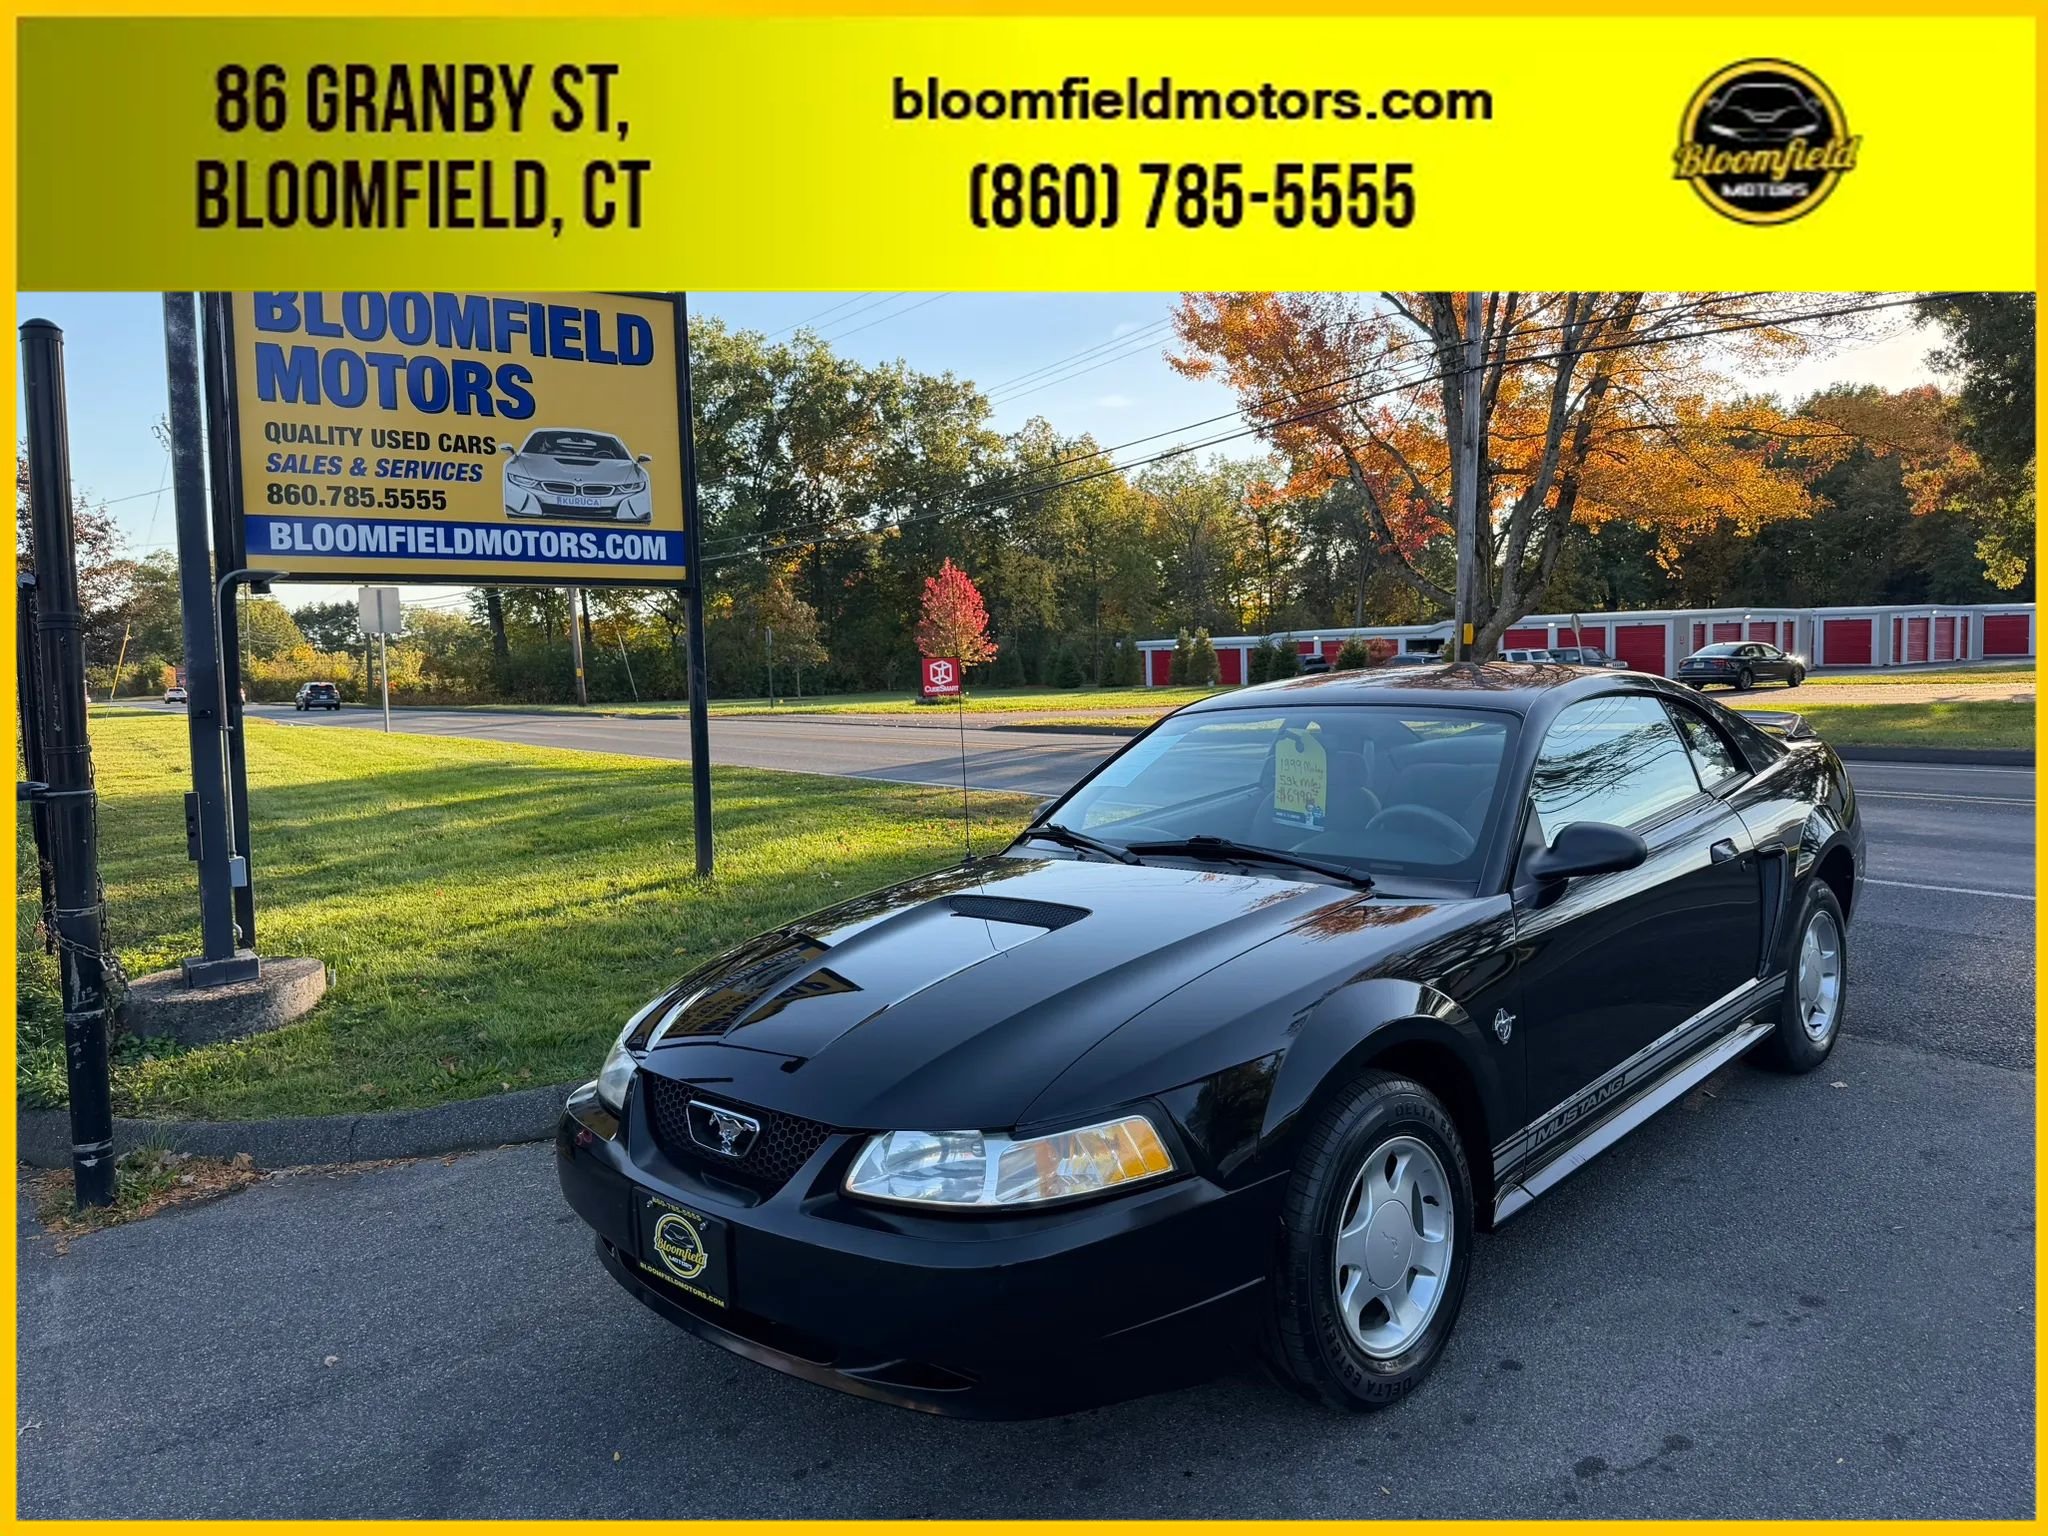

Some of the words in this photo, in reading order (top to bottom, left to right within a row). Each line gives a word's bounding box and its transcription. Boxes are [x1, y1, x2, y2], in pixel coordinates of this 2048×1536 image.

[254, 291, 654, 366] BLOOMFIELD
[254, 342, 536, 420] MOTORS
[265, 421, 363, 448] QUALITY
[371, 427, 431, 452] USED
[438, 431, 497, 456] CARS
[265, 452, 342, 477] SALES
[350, 455, 367, 477] &
[374, 458, 483, 483] SERVICES
[266, 483, 448, 511] 860.785.5555
[269, 521, 667, 561] BLOOMFIELDMOTORS.COM
[1394, 1102, 1436, 1125] DELTA
[1535, 1076, 1625, 1144] MUSTANG
[657, 1238, 705, 1266] Bloomfield
[640, 1261, 725, 1308] BLOOMFIELDMOTORS.COM
